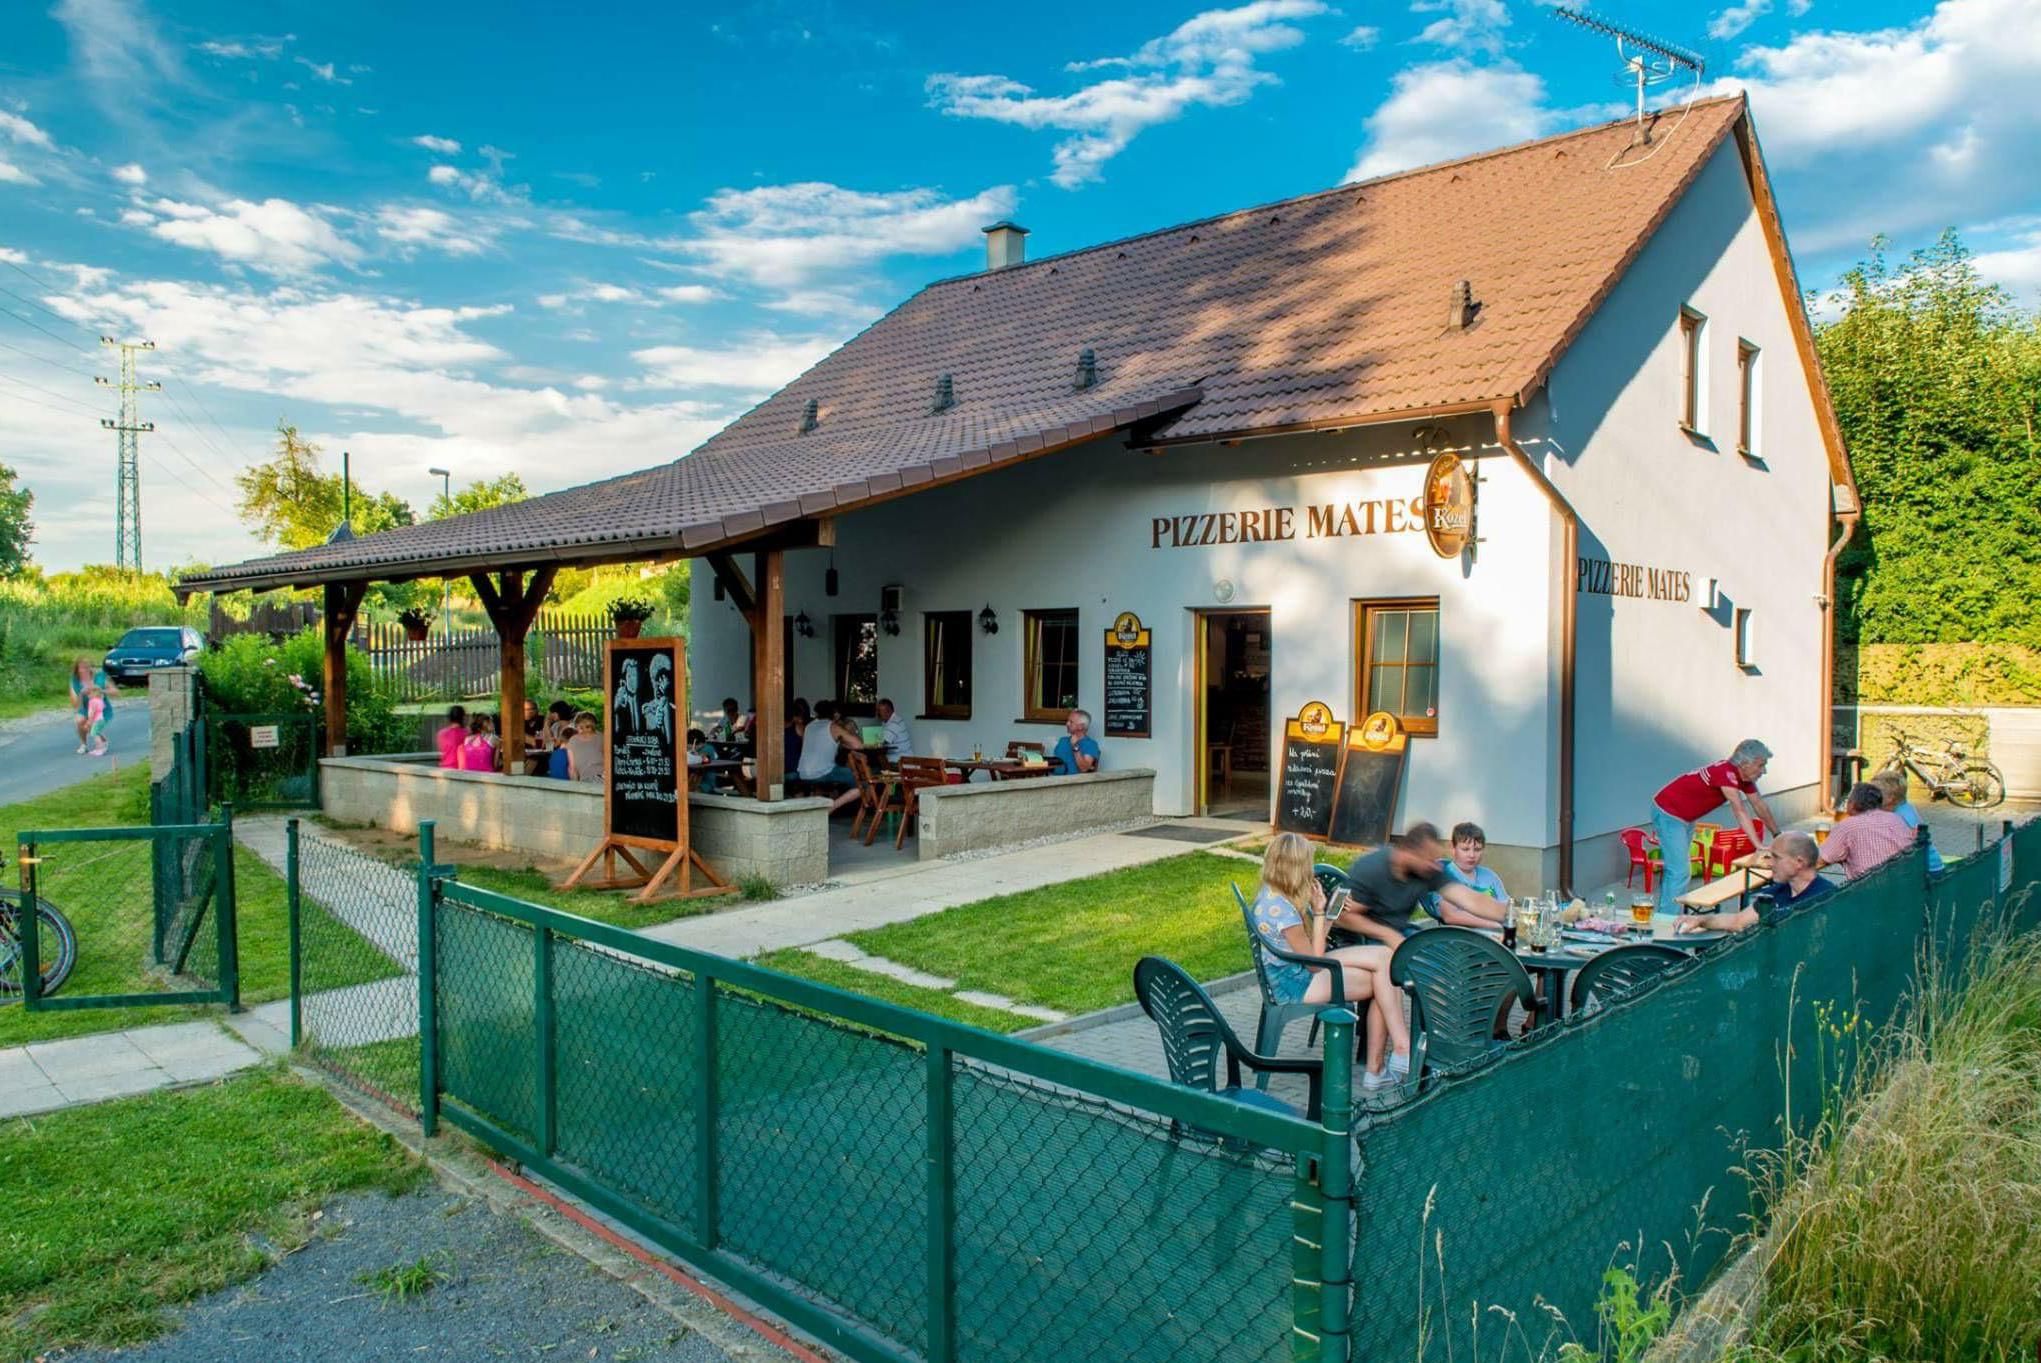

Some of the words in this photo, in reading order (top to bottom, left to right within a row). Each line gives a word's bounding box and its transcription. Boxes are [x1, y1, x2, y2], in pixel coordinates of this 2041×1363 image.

[1152, 507, 1296, 549] PIZZERIE
[1306, 496, 1424, 539] MATES
[1577, 556, 1643, 598] PIZZERIE
[1647, 566, 1690, 602] MATES
